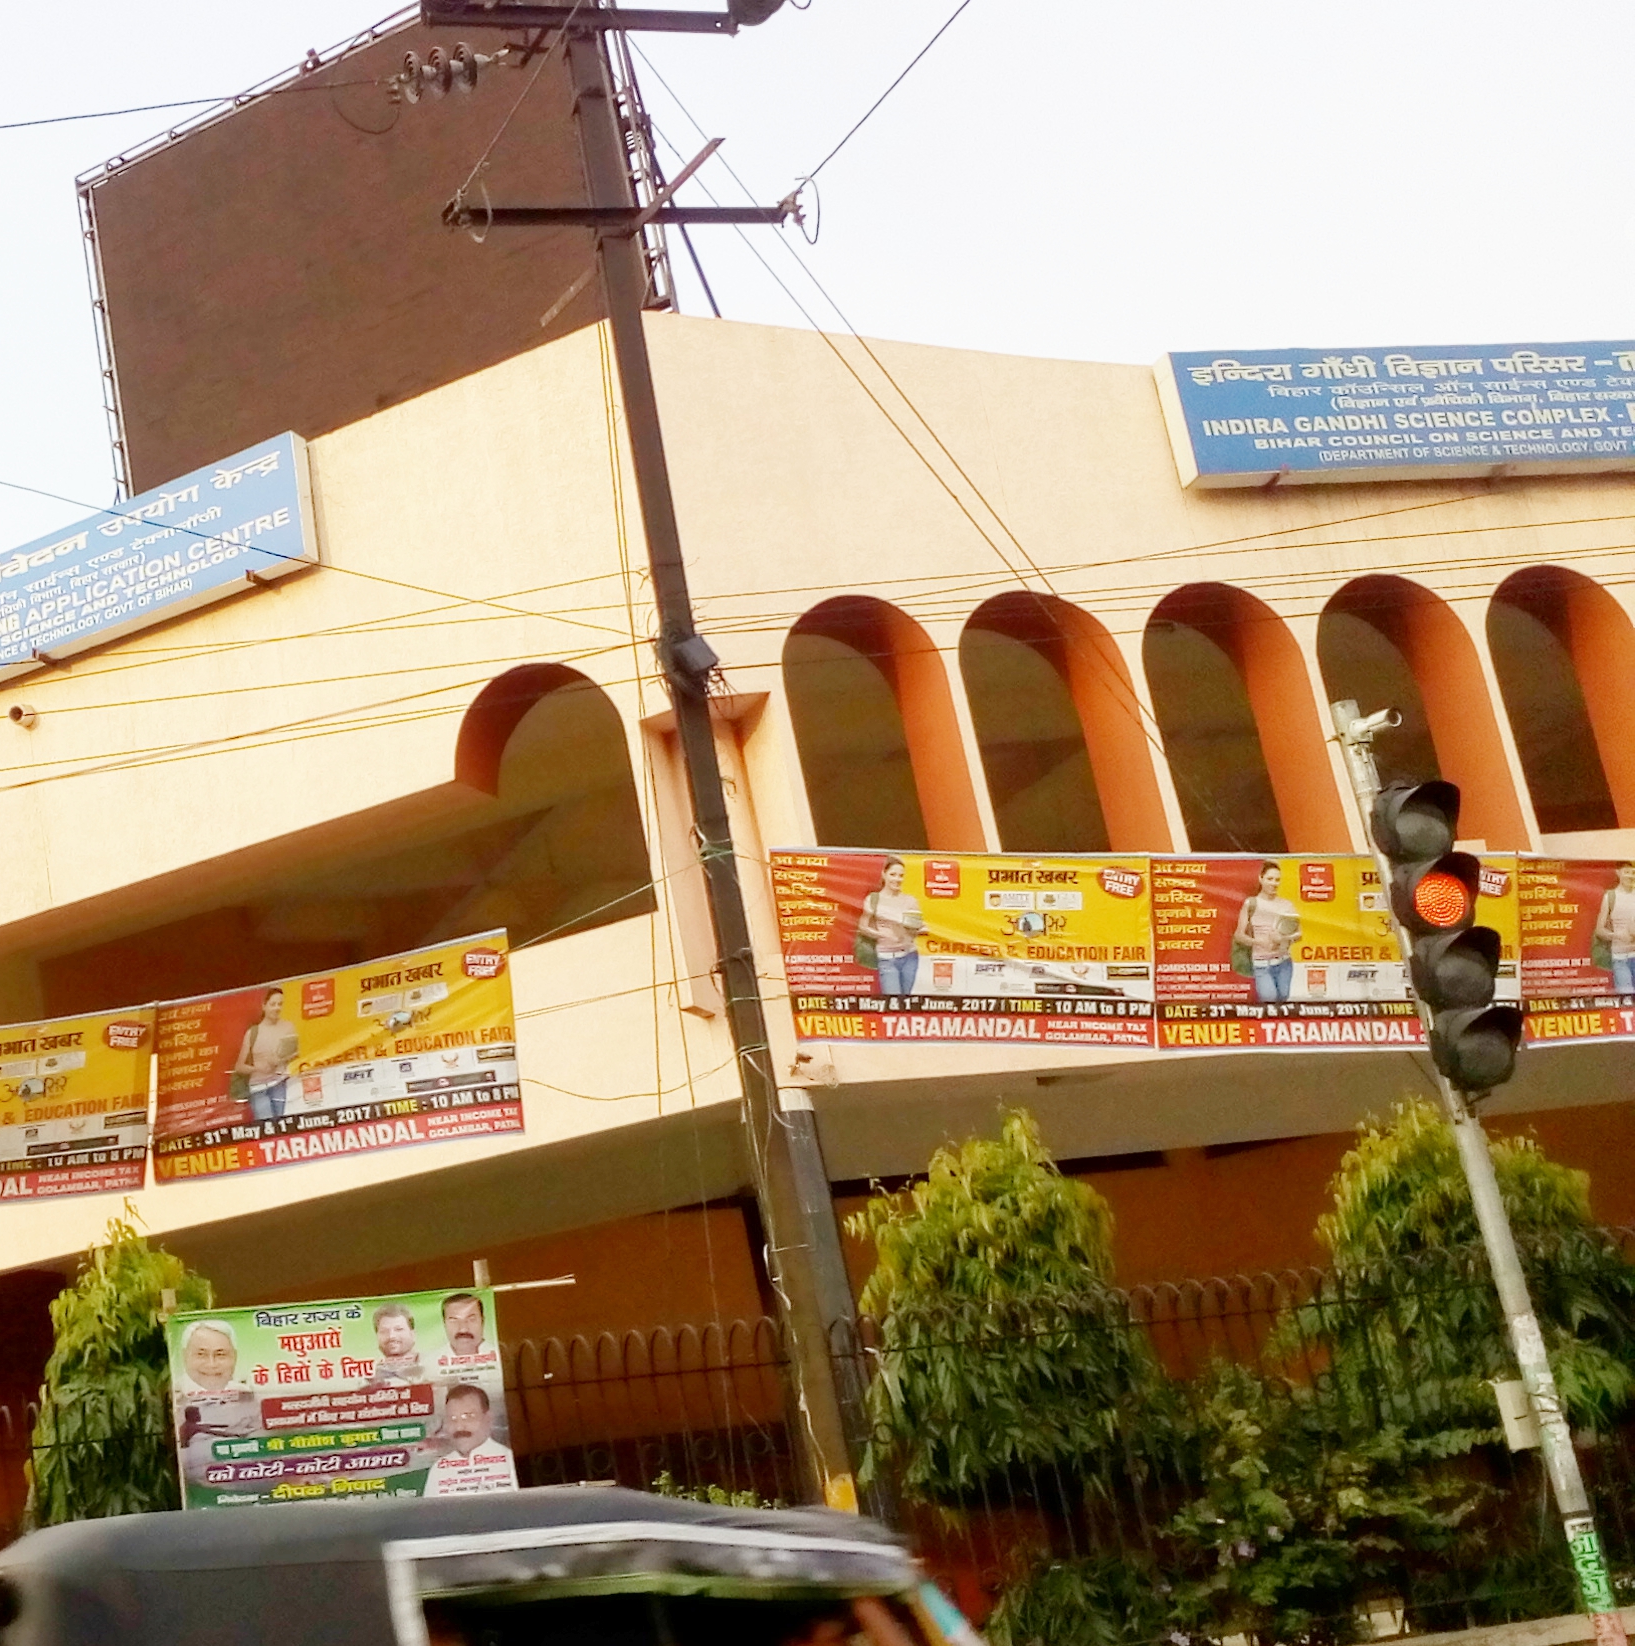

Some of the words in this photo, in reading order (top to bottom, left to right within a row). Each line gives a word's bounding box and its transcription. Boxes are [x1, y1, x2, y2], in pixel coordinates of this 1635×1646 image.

[1187, 359, 1293, 386] इन्दिरा
[1298, 355, 1377, 379] गाँधी
[1383, 354, 1484, 379] विज्ञान
[1489, 350, 1586, 374] परिसर
[1266, 384, 1322, 397] बिहार
[1434, 380, 1474, 392] ऑन
[1202, 418, 1289, 436] INDIRA
[1294, 414, 1388, 432] GANDHI
[1393, 411, 1496, 429] SCIENCE
[1501, 407, 1612, 426] COMPLEX
[1254, 437, 1323, 449] BIHAR
[1328, 434, 1424, 447] COUNCIL
[1429, 432, 1459, 443] ON
[1465, 429, 1555, 442] SCIENCE
[1561, 427, 1602, 438] AND
[1319, 448, 1409, 463] (DEPARTMENT
[1413, 447, 1430, 458] OF
[1433, 445, 1489, 457] SCIENCE
[1492, 445, 1502, 455] &
[96, 484, 200, 536] उपयोग
[210, 450, 281, 489] केन्द्र
[25, 551, 181, 626] APPLICATION
[187, 507, 291, 560] CENTRE
[0, 609, 76, 647] SCIENCE
[81, 594, 119, 616] AND
[122, 540, 252, 598] TECHNOLOGY
[19, 641, 28, 652] &
[137, 592, 153, 607] OF
[155, 577, 193, 601] BIHAR)
[988, 870, 1032, 884] प्रभात
[1036, 870, 1078, 884] खबर
[1105, 882, 1134, 897] FREE
[1027, 946, 1108, 960] EDUCATION
[1113, 946, 1145, 960] FAIR
[1301, 946, 1373, 960] CAREER
[1379, 946, 1392, 960] &
[360, 972, 401, 993] प्रभात
[405, 962, 444, 982] खबर
[798, 997, 827, 1010] DATE
[859, 998, 885, 1012] May
[889, 997, 899, 1010] &
[921, 998, 957, 1012] June,
[962, 999, 996, 1011] 2017
[1010, 1000, 1042, 1012] TIME
[1055, 1001, 1071, 1013] 10
[1075, 1002, 1096, 1014] AM
[1100, 1002, 1114, 1015] to
[1117, 1003, 1125, 1015] 8
[1129, 1003, 1151, 1016] PM
[1165, 1005, 1198, 1018] DATE
[1236, 1005, 1264, 1019] May
[1298, 1004, 1334, 1017] June,
[1337, 1003, 1368, 1016] 2017
[1381, 1003, 1414, 1015] TIME
[1529, 999, 1559, 1011] DATE
[797, 1015, 865, 1037] VENUE
[882, 1016, 1041, 1038] TARAMANDAL
[1126, 1023, 1147, 1032] TAX
[1163, 1022, 1242, 1044] VENUE
[1261, 1021, 1415, 1043] TARAMANDAL
[1529, 1013, 1603, 1038] VENUE
[39, 1032, 83, 1050] खबर
[394, 1030, 476, 1055] EDUCATION
[481, 1026, 513, 1042] FAIR
[25, 1098, 107, 1120] EDUCATION
[113, 1093, 145, 1109] FAIR
[159, 1136, 192, 1153] DATE
[231, 1126, 260, 1140] May
[297, 1113, 334, 1130] June,
[336, 1106, 371, 1123] 2017
[384, 1099, 419, 1116] TIME
[430, 1096, 448, 1109] 10
[452, 1091, 473, 1106] AM
[476, 1090, 489, 1103] to
[156, 1148, 240, 1177] VENUE
[259, 1120, 425, 1163] TARAMANDAL
[256, 1309, 299, 1328] बिहार
[302, 1310, 340, 1322] राज्य
[344, 1305, 362, 1319] के
[251, 1363, 270, 1385] के
[275, 1360, 312, 1384] हितों
[316, 1358, 335, 1380] के
[339, 1355, 376, 1378] लिए
[207, 1464, 235, 1481] को
[237, 1456, 342, 1479] कोटी-कोटी
[345, 1452, 406, 1469] आभार
